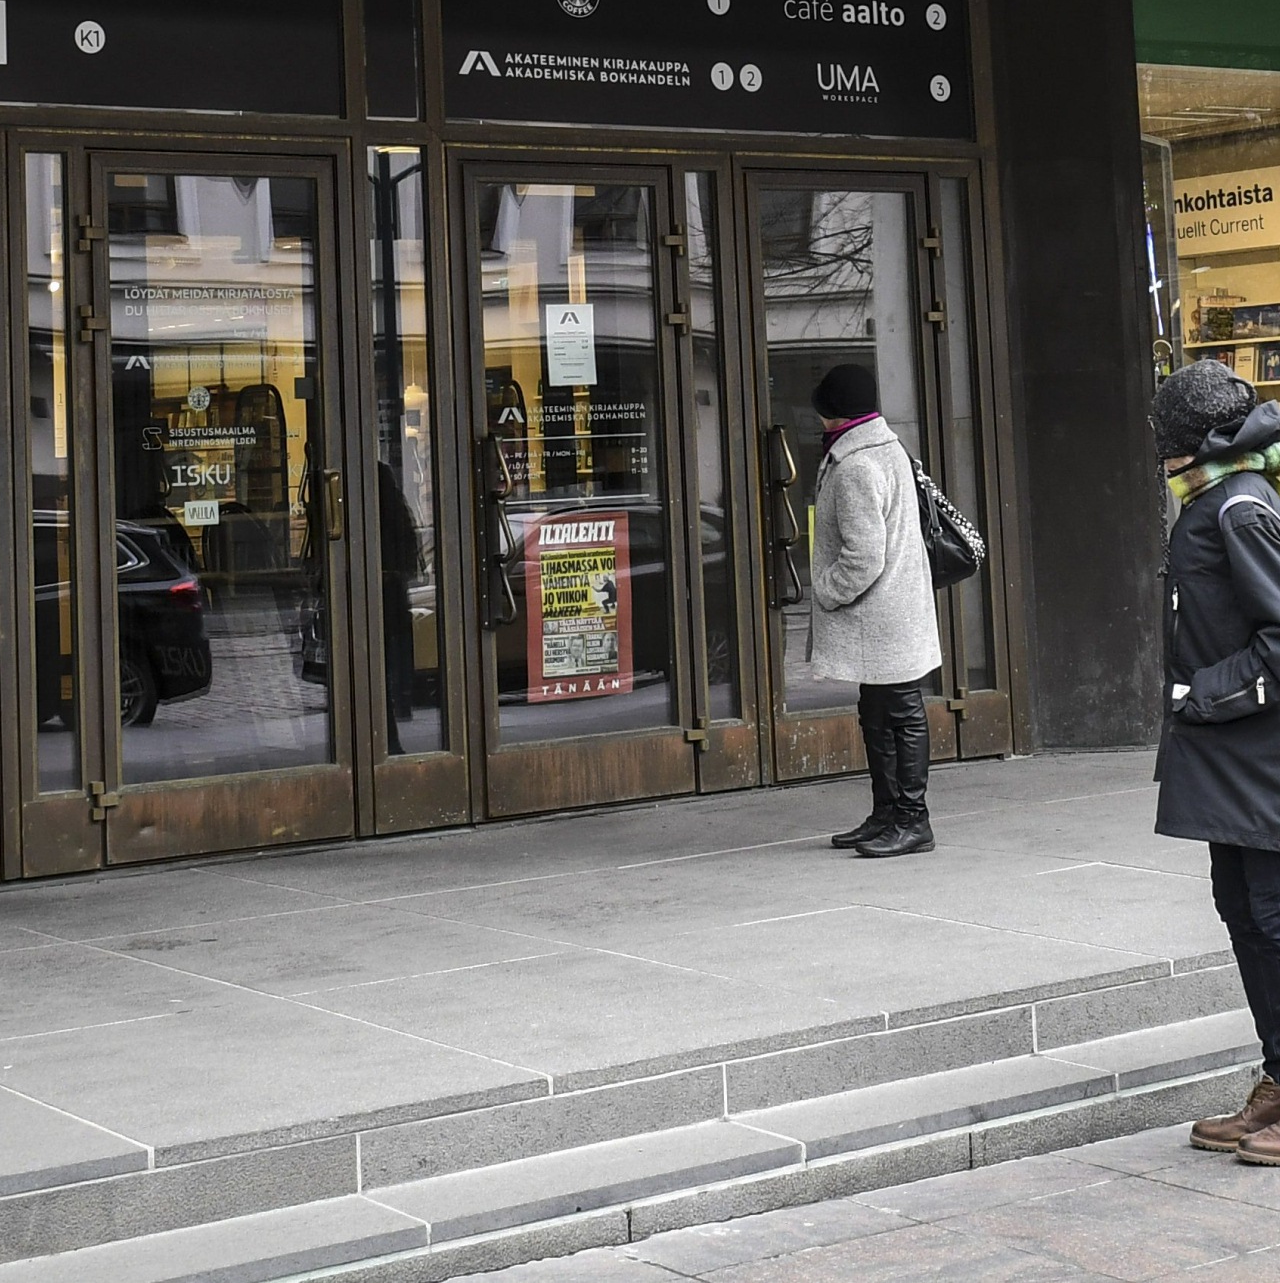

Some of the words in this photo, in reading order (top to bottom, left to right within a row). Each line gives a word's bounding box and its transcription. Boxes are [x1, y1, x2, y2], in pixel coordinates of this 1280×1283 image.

[562, 0, 594, 15] COFFEE
[842, 0, 905, 27] aalto
[79, 29, 101, 49] K1
[505, 52, 599, 70] AKATEEMINEN
[602, 57, 690, 74] KIRJAKAUPPA
[505, 66, 596, 83] AKADEMISKA
[600, 70, 691, 87] BOKHANDELN
[816, 63, 880, 93] UMA
[822, 94, 879, 104] WORKSPACE
[1174, 184, 1274, 215] nkohtaista
[1209, 214, 1265, 236] Current
[124, 285, 169, 300] LÖYDÄT
[172, 285, 215, 300] MEIDÄT
[217, 287, 296, 300] KIRJATALOSTA
[589, 402, 645, 412] KIRJAKAUPPA
[587, 411, 646, 422] BOKHANDELN
[169, 426, 256, 437] SISUSTUSMAAILMA
[171, 464, 231, 487] ISKU
[538, 521, 616, 545] ILTALEHTI
[541, 558, 599, 575] LIHASMASSA
[542, 573, 590, 591] VÄHENTYÄ
[543, 592, 555, 606] JO
[556, 589, 588, 605] VIIKON
[542, 678, 620, 696] TÄNÄÄN
